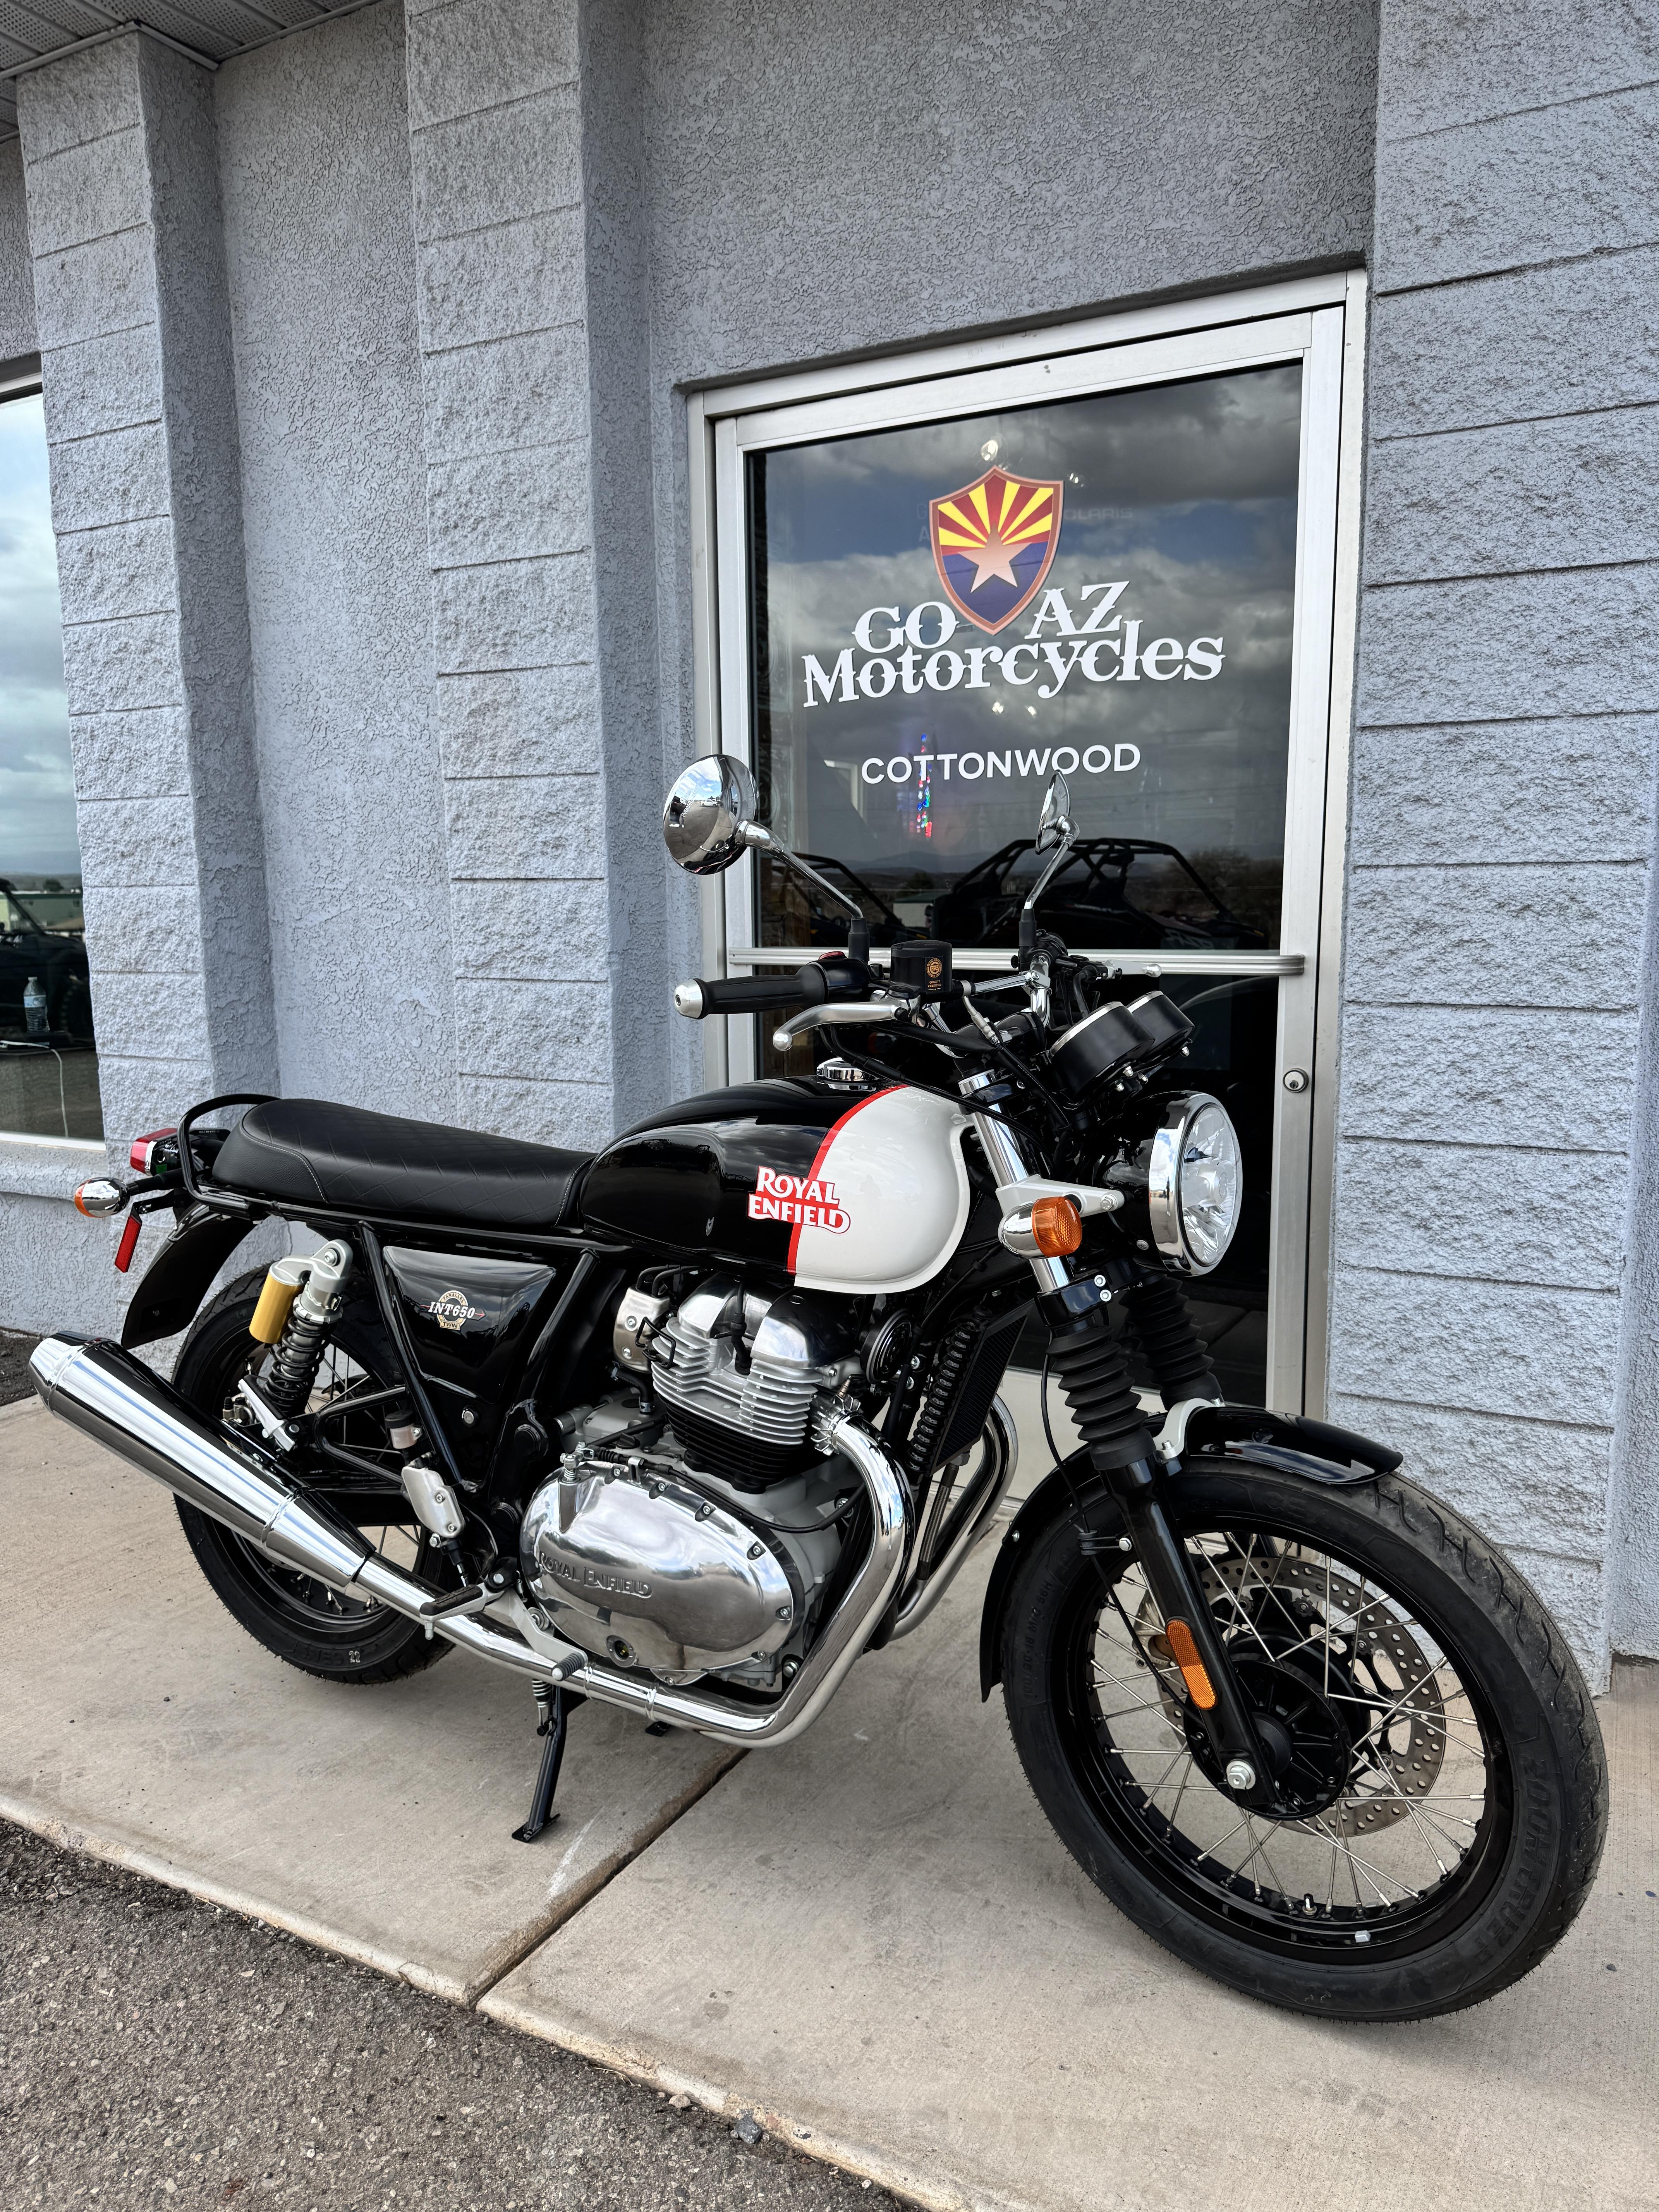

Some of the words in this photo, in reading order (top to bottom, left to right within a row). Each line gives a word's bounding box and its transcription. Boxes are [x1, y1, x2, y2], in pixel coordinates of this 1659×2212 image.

[1064, 507, 1133, 521] OLARIS
[852, 601, 959, 653] GO
[1025, 581, 1130, 639] AZ
[804, 620, 1225, 707] Motorcycles
[861, 743, 1140, 784] COTTONWOOD
[757, 1167, 839, 1204] ROYAL
[749, 1194, 850, 1233] ENFIELD
[428, 1302, 475, 1319] INT650
[444, 1293, 464, 1303] PARALLEL
[539, 1550, 580, 1583] ROYAL
[584, 1566, 653, 1599] ENFIELD
